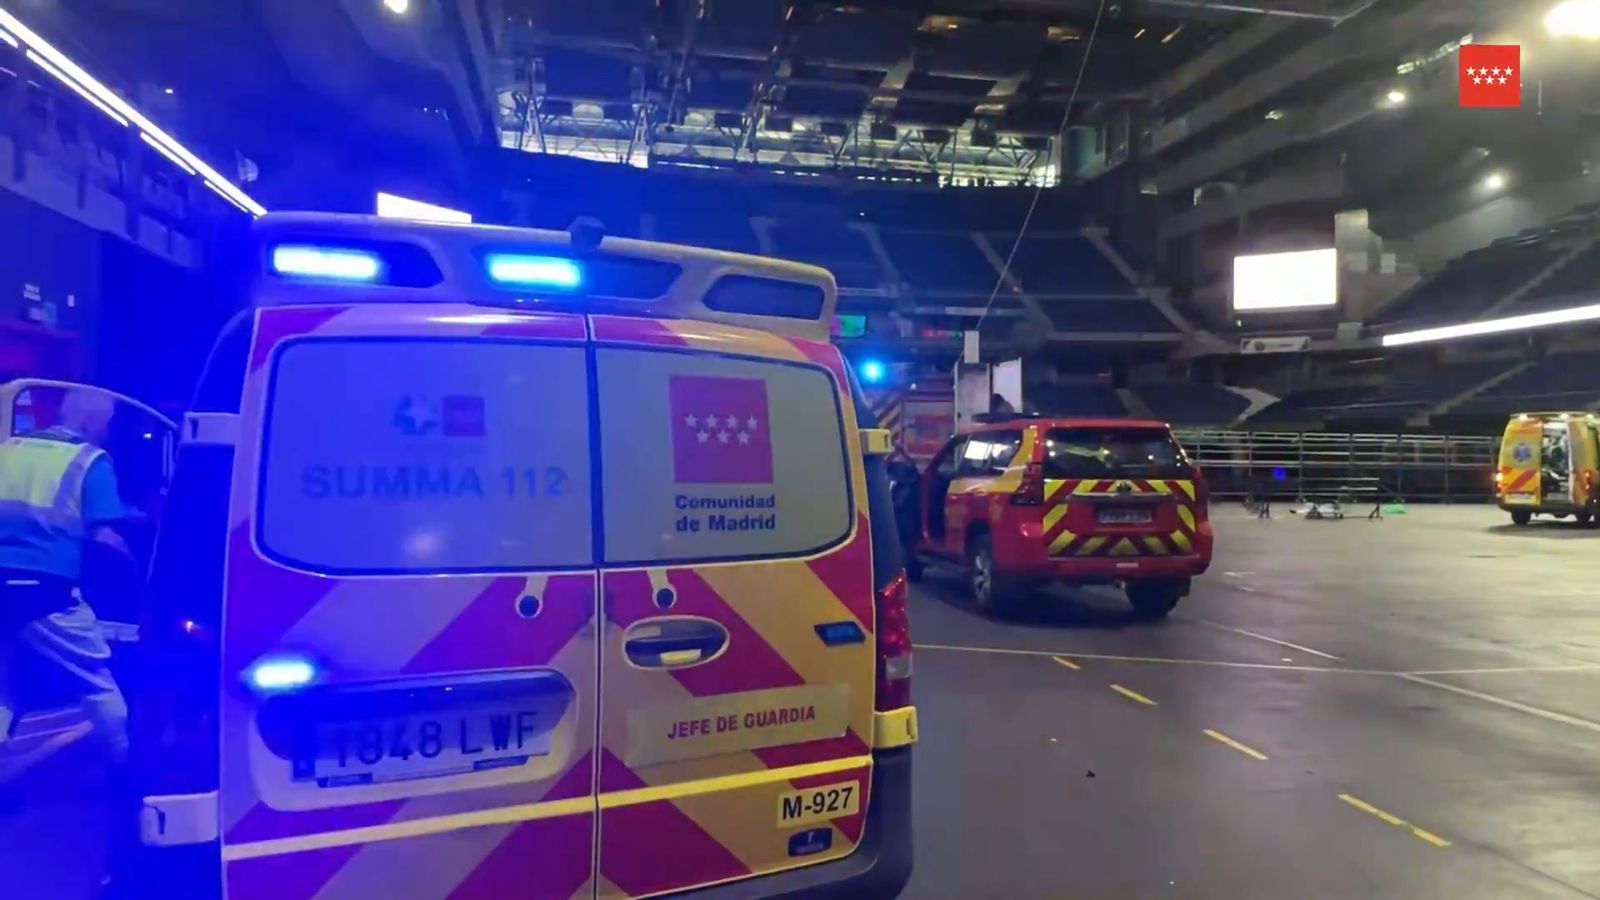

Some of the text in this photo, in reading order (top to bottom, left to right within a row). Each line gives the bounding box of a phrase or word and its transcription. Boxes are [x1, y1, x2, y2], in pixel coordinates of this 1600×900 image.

[301, 464, 568, 499] SUMMA 112
[675, 494, 776, 510] Comunidad
[675, 514, 776, 532] de Madrid
[334, 710, 538, 768] 1848 LWF
[667, 705, 816, 739] JEFE DE GUARDIA
[782, 786, 853, 820] M-927
